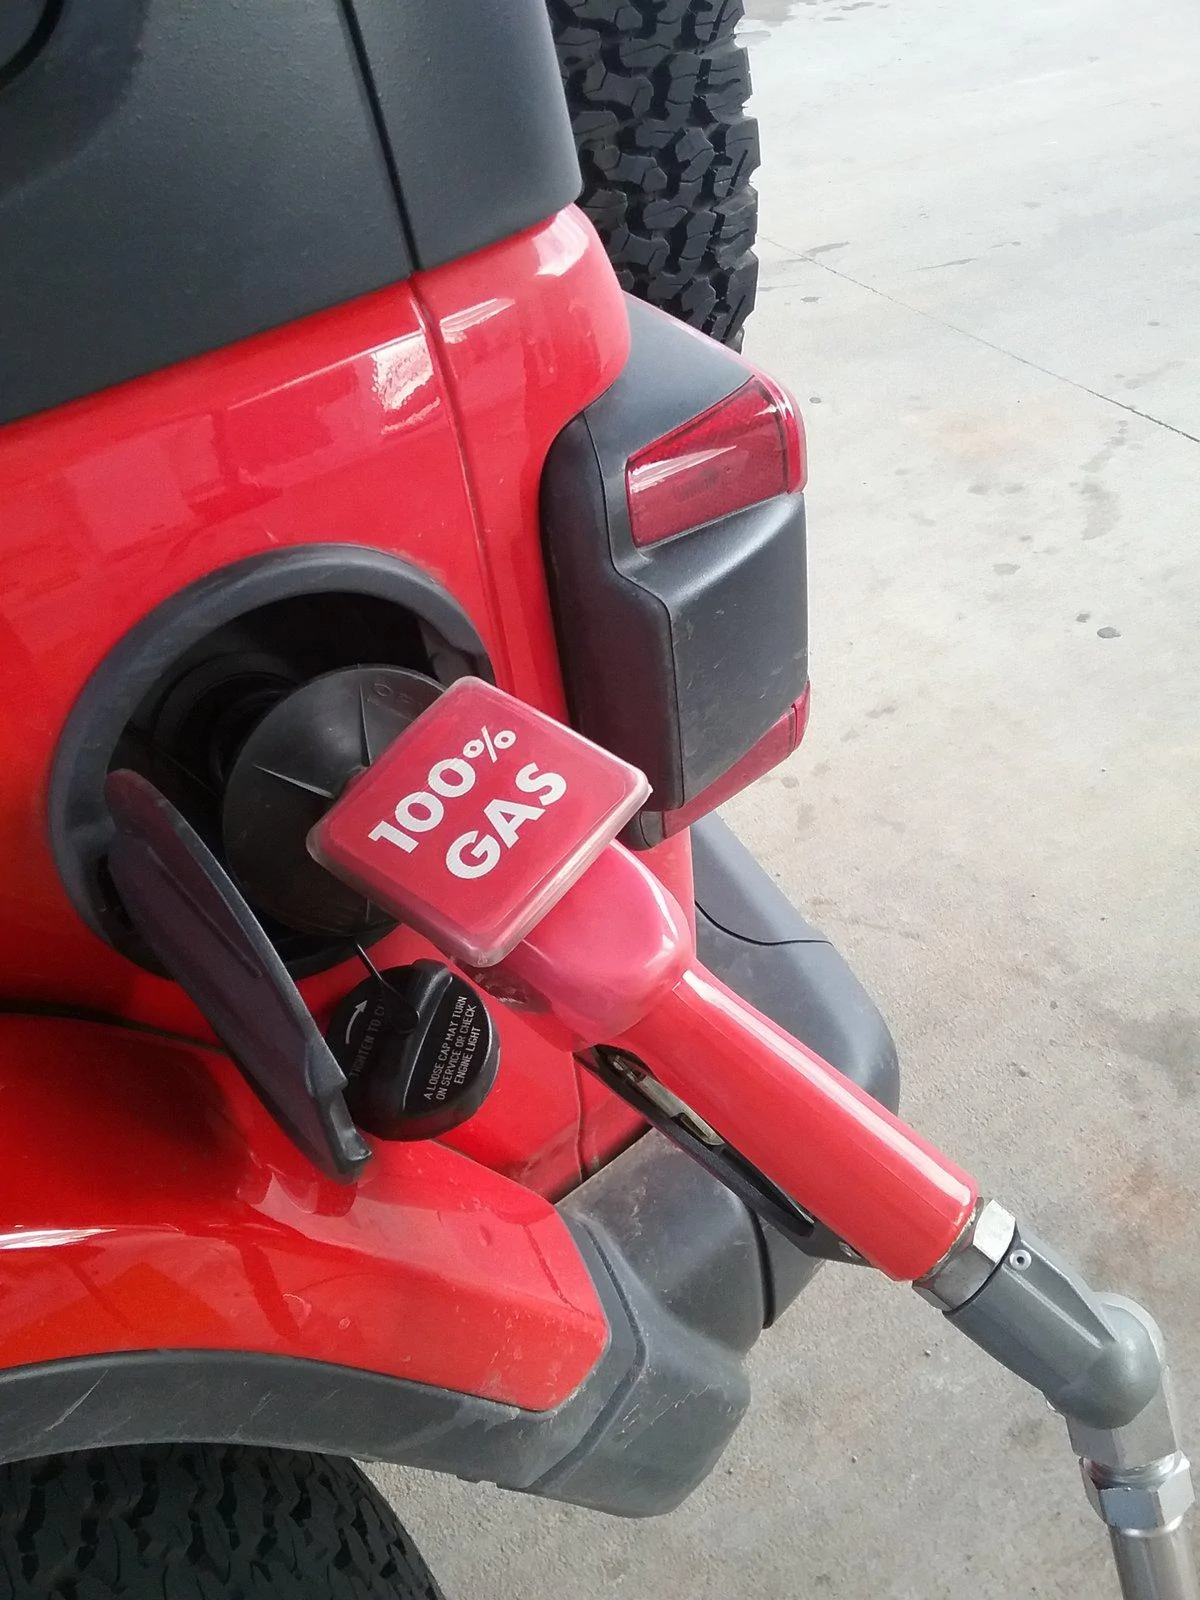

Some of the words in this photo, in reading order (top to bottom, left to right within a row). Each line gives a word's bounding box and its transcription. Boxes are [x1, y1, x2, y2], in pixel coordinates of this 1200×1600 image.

[368, 725, 516, 853] 100%
[446, 762, 567, 879] GAS
[452, 996, 467, 1018] TURN
[460, 1004, 477, 1034] CHECK
[445, 1021, 458, 1041] MAY
[455, 1036, 465, 1047] OR
[438, 1042, 450, 1061] CAP
[454, 1053, 473, 1085] ENGINE
[466, 1026, 480, 1052] LIGHT
[426, 1062, 444, 1090] LOOSE
[441, 1049, 461, 1086] SERVICE
[424, 1092, 433, 1100] A
[436, 1087, 448, 1100] ON
